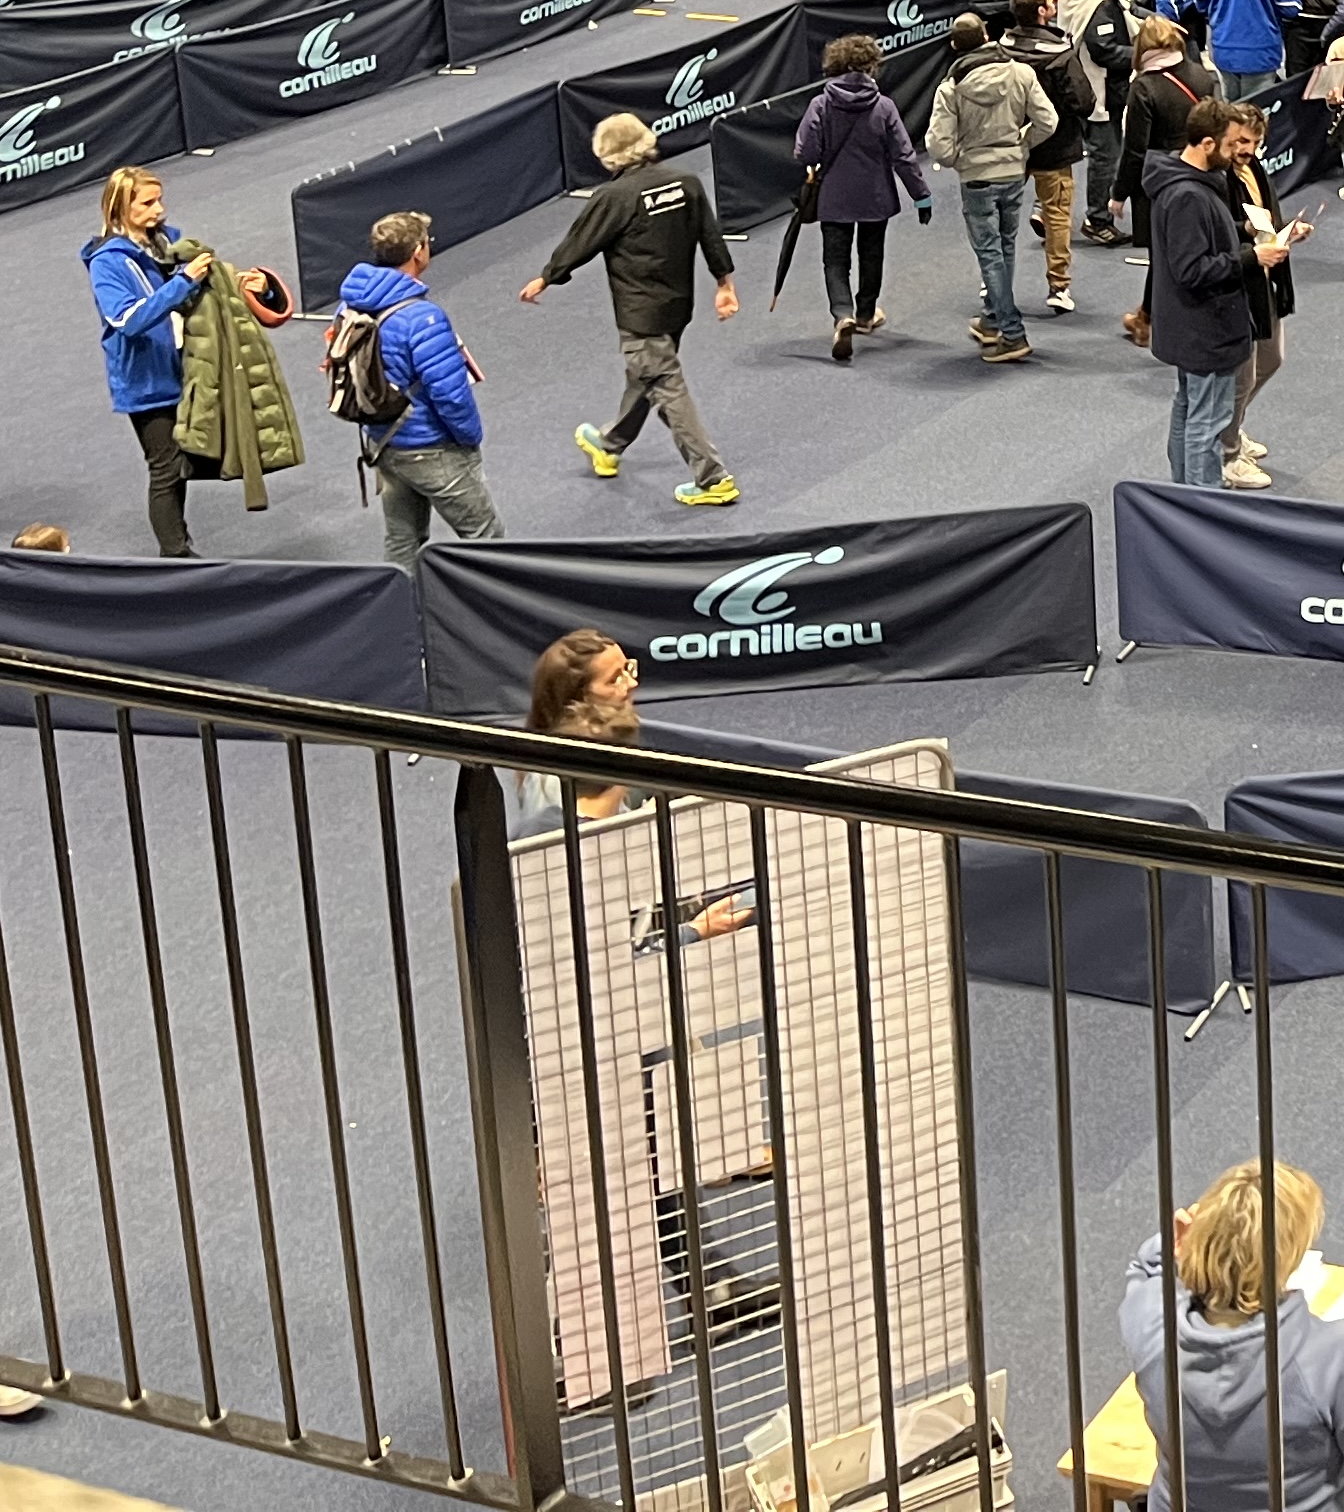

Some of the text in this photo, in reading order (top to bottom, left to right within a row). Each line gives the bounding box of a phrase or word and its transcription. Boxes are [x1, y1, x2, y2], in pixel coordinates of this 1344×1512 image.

[279, 54, 377, 98] cornilleau
[652, 91, 735, 136] cornilleau
[649, 620, 883, 663] cornilleau
